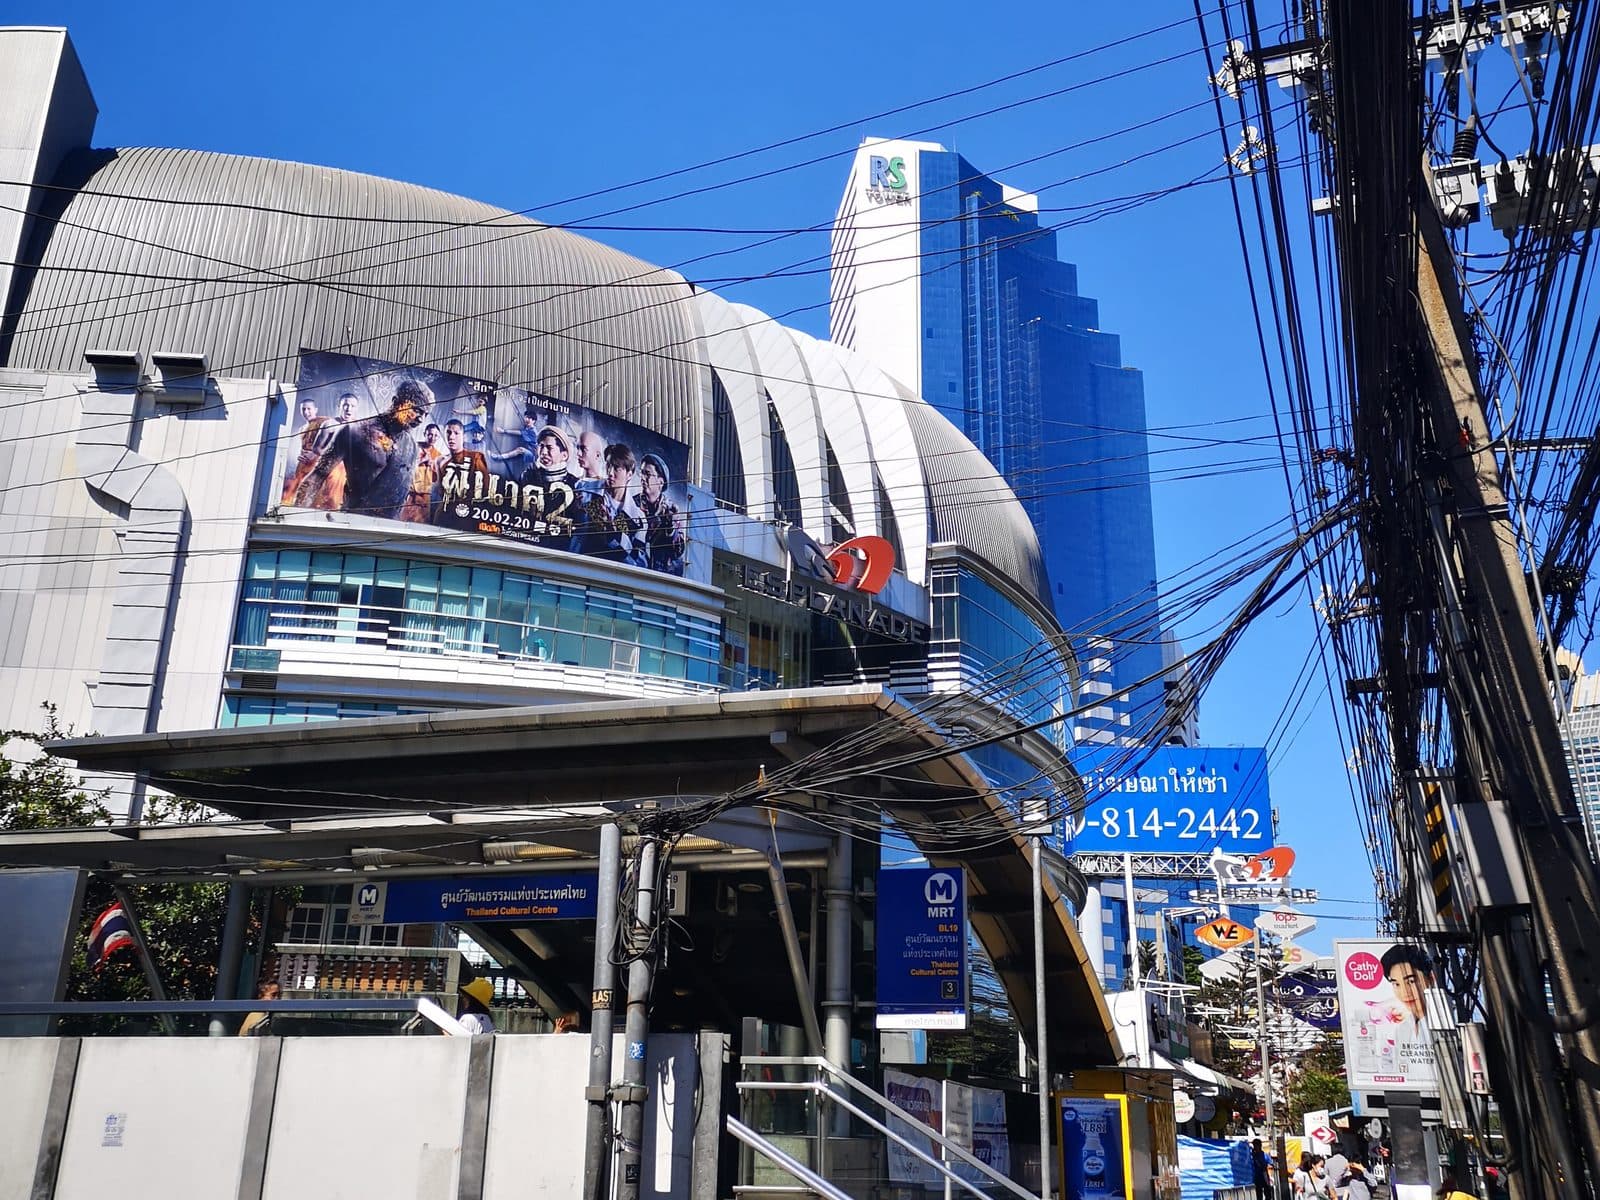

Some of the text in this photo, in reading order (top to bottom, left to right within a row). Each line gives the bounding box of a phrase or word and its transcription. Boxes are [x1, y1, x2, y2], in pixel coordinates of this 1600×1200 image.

[870, 155, 907, 190] RS
[866, 188, 912, 206] TOWER
[472, 507, 531, 529] 20.02.20
[743, 563, 925, 643] ESPLANADE
[441, 884, 587, 908] ศูนย์วัฒนธรรมแห่งประเทศไทย
[466, 905, 558, 916] Thailand Cultural Centre
[928, 906, 955, 918] MRT
[1273, 911, 1298, 924] Tops
[938, 924, 958, 932] BL19
[1212, 925, 1238, 939] WE
[931, 961, 958, 969] Thailand
[1349, 961, 1378, 975] Cathy
[1353, 971, 1374, 981] Doll
[946, 982, 953, 992] 3
